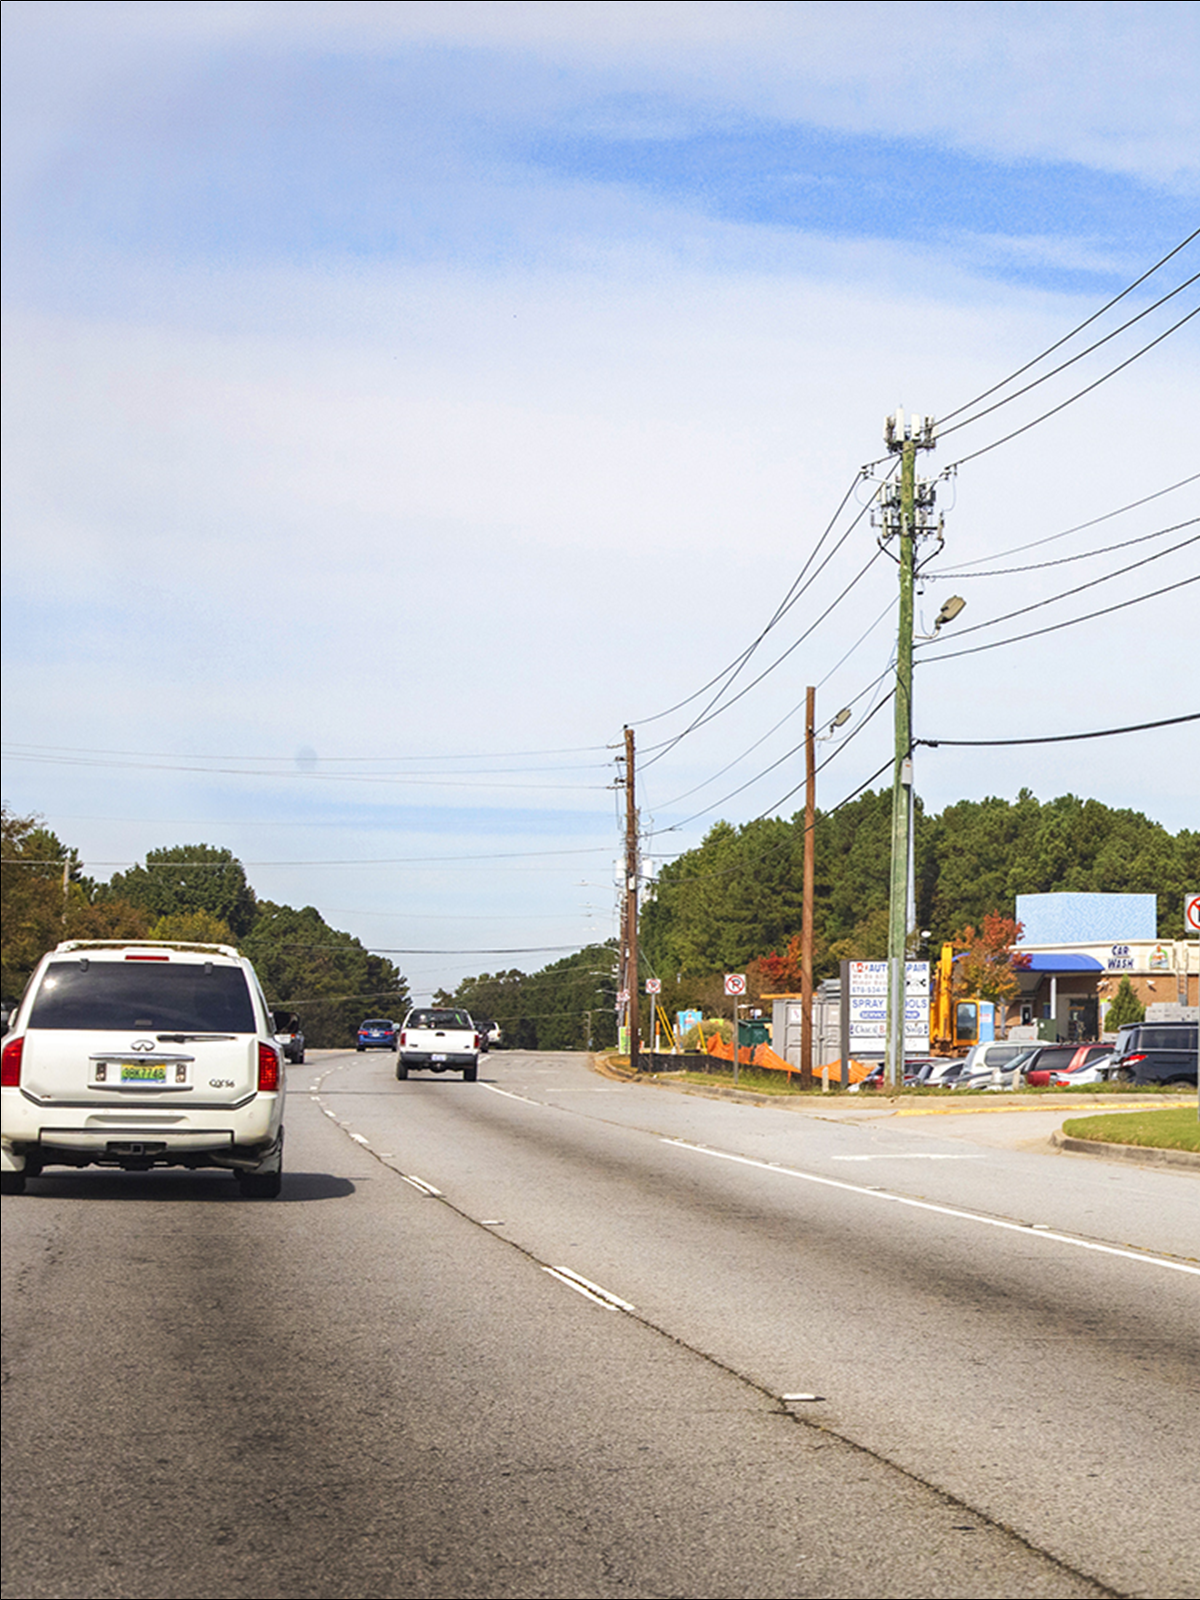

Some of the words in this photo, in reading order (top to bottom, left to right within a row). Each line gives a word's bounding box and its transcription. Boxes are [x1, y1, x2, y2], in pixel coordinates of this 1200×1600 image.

[1112, 945, 1129, 956] CAR
[1108, 959, 1134, 969] WASH
[852, 999, 884, 1009] SPRAY
